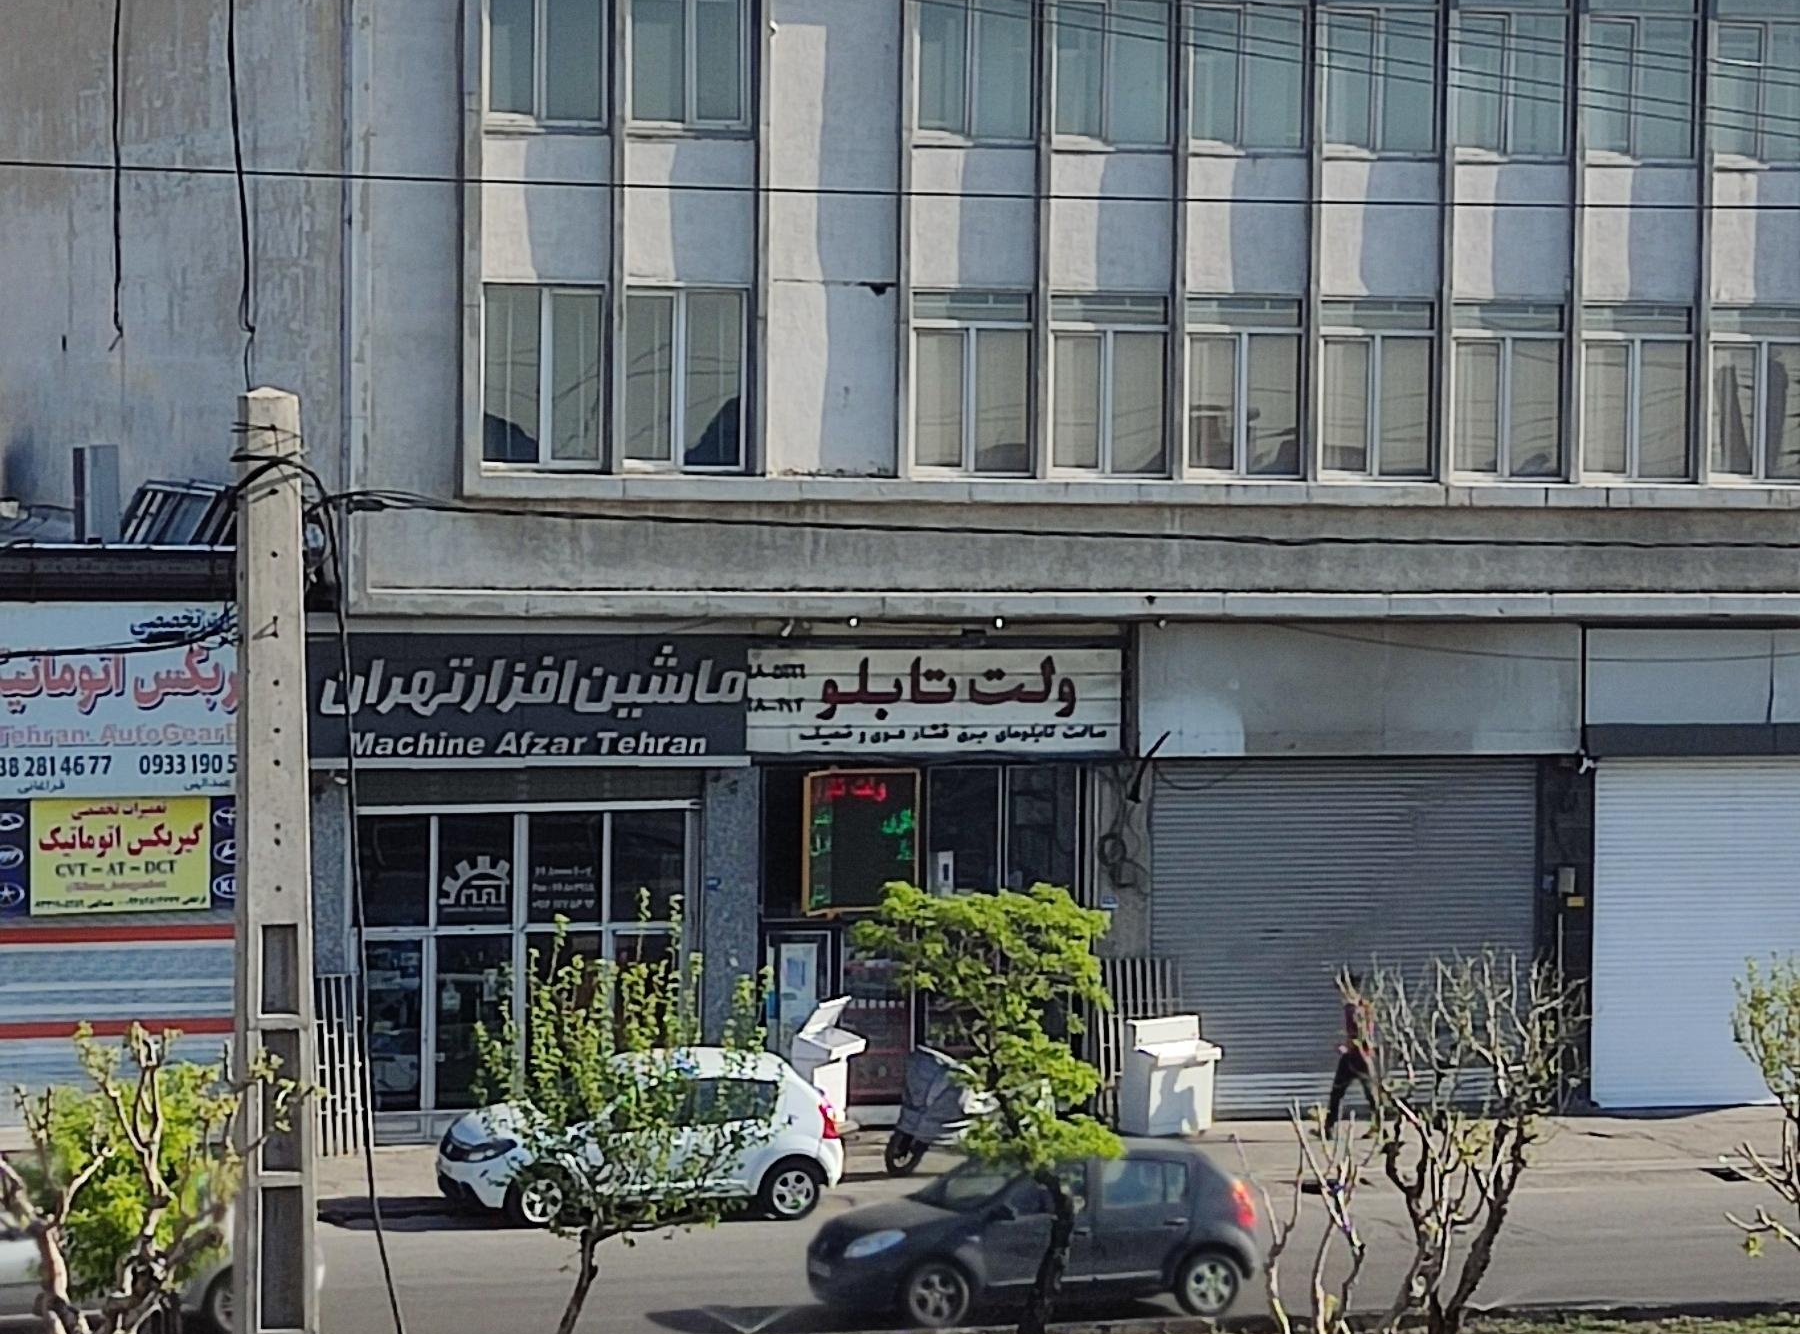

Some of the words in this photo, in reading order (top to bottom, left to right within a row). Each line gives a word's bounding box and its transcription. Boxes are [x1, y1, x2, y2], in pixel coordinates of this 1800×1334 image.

[320, 658, 474, 717] تهران
[460, 656, 578, 714] افزار
[574, 645, 747, 718] ماشین
[815, 656, 957, 721] تابلو
[968, 655, 1076, 718] ولت
[352, 731, 486, 756] Machine
[495, 730, 589, 755] Afzar
[597, 730, 707, 754] Tehran
[39, 825, 121, 858] اتوماتیک
[127, 822, 204, 856] گیربکس
